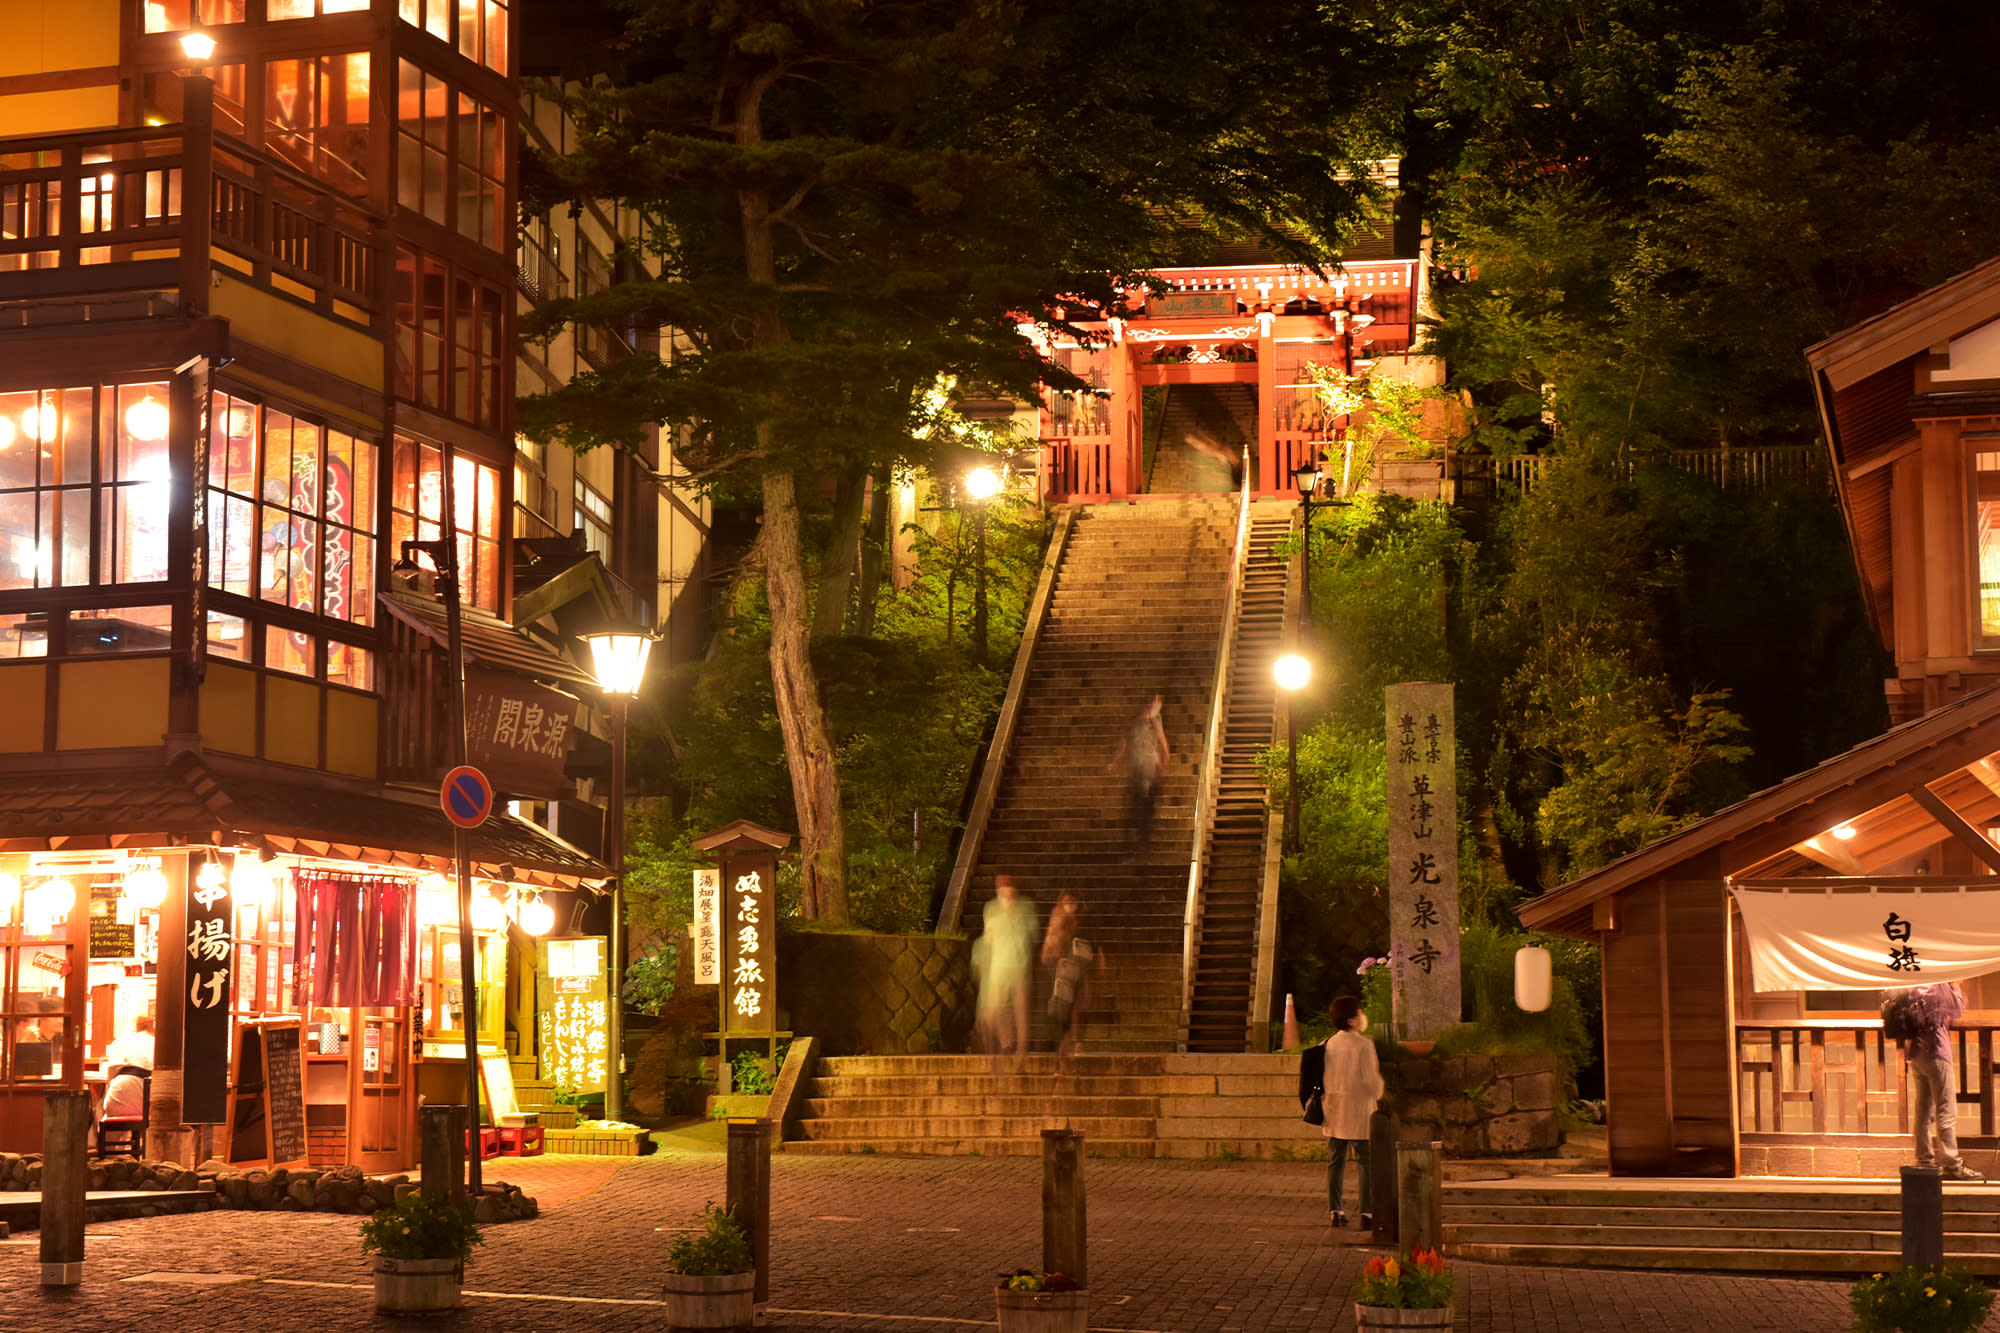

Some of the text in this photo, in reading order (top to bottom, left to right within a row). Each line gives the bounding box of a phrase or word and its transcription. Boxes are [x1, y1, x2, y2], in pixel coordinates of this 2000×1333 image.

[493, 697, 569, 759] 源泉閣
[1397, 713, 1419, 765] 豊山派
[1423, 713, 1442, 764] 真言宗
[187, 861, 231, 1009] 串揚げ
[698, 875, 716, 977] 湯畑展望露天風呂
[1883, 912, 1921, 972] 白旗
[570, 995, 586, 1088] お好み焼き
